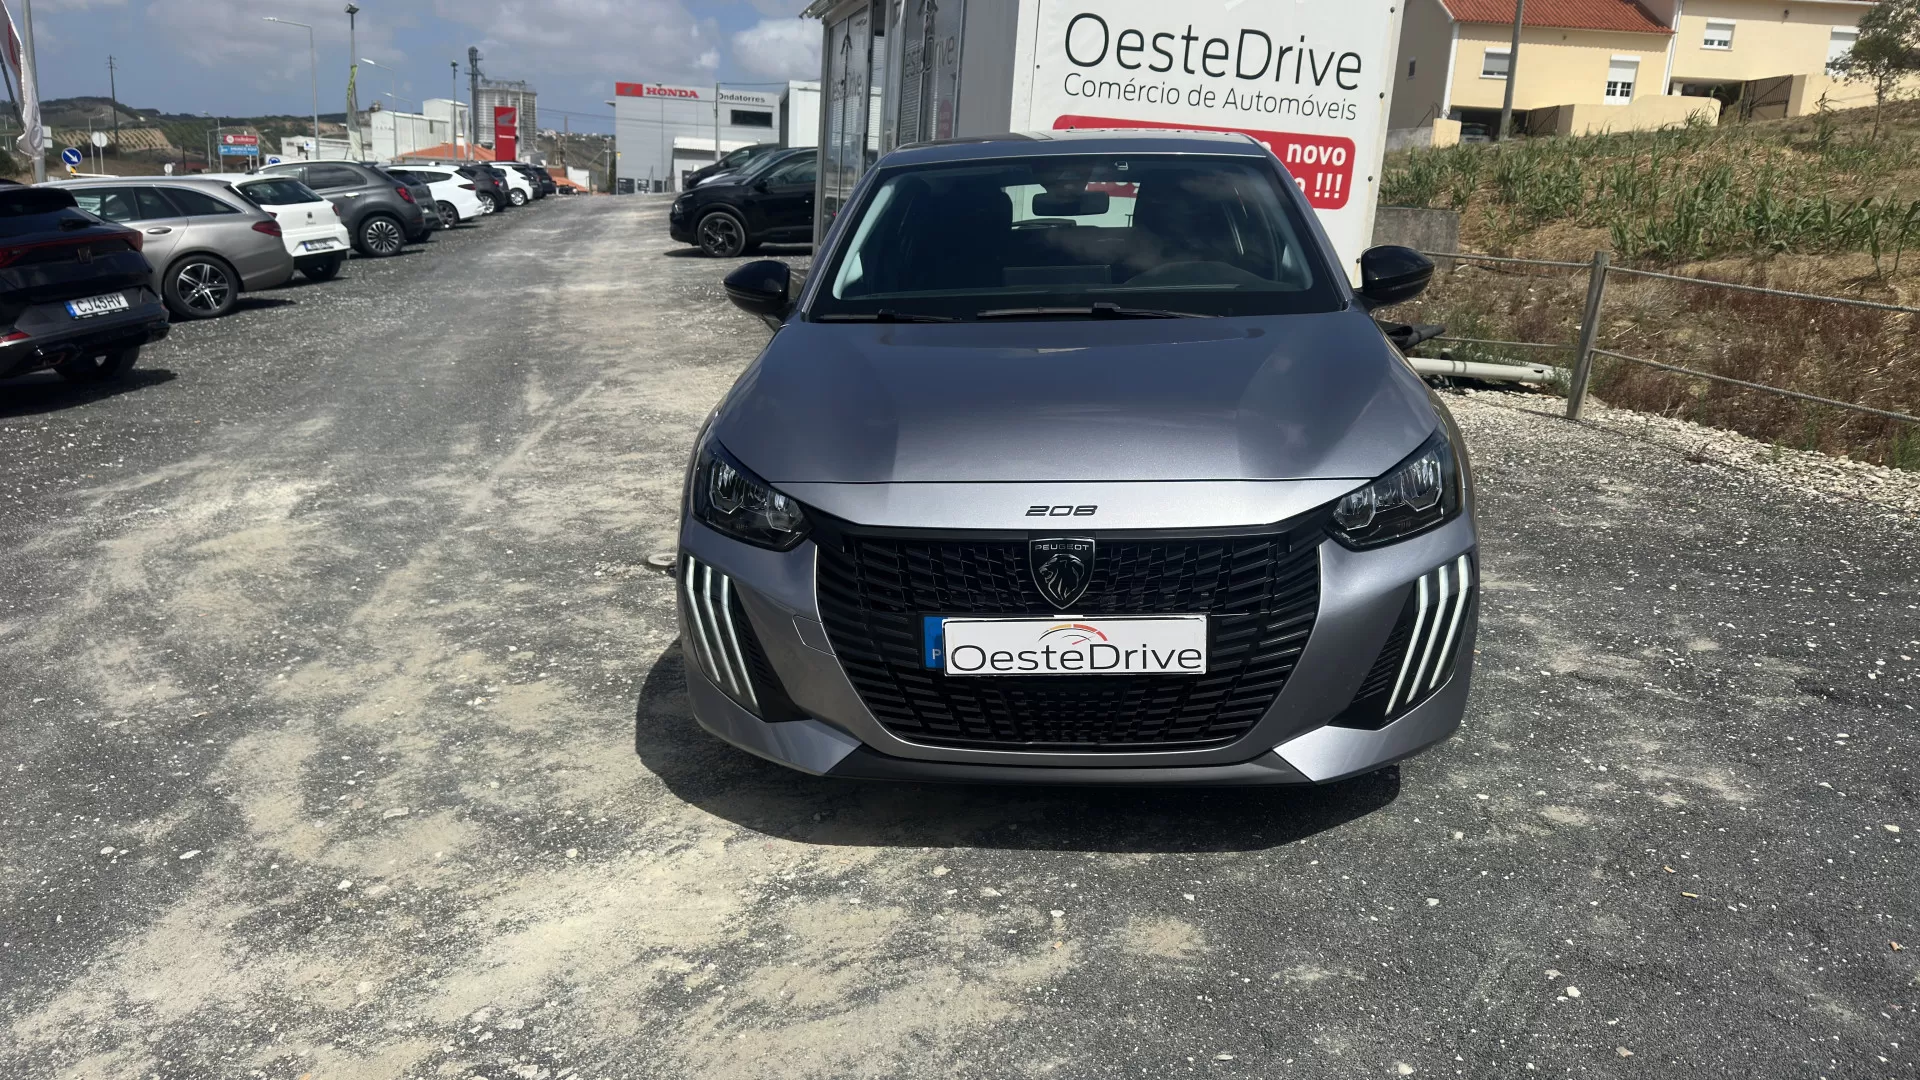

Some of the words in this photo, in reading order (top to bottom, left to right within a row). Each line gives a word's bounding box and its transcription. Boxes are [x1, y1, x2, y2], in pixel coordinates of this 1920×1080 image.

[1064, 12, 1362, 91] OesteDrive
[645, 87, 699, 99] HONDA
[719, 93, 765, 103] Ondatorres
[1063, 72, 1180, 105] Comércio
[1187, 85, 1216, 108] de
[1222, 87, 1357, 121] Automóveis
[1286, 143, 1347, 167] novo
[76, 294, 122, 313] CJ45HV
[1025, 505, 1098, 516] 208
[1034, 543, 1090, 551] PEUGEOT
[932, 648, 942, 660] P
[950, 643, 1202, 671] OesteDrive
